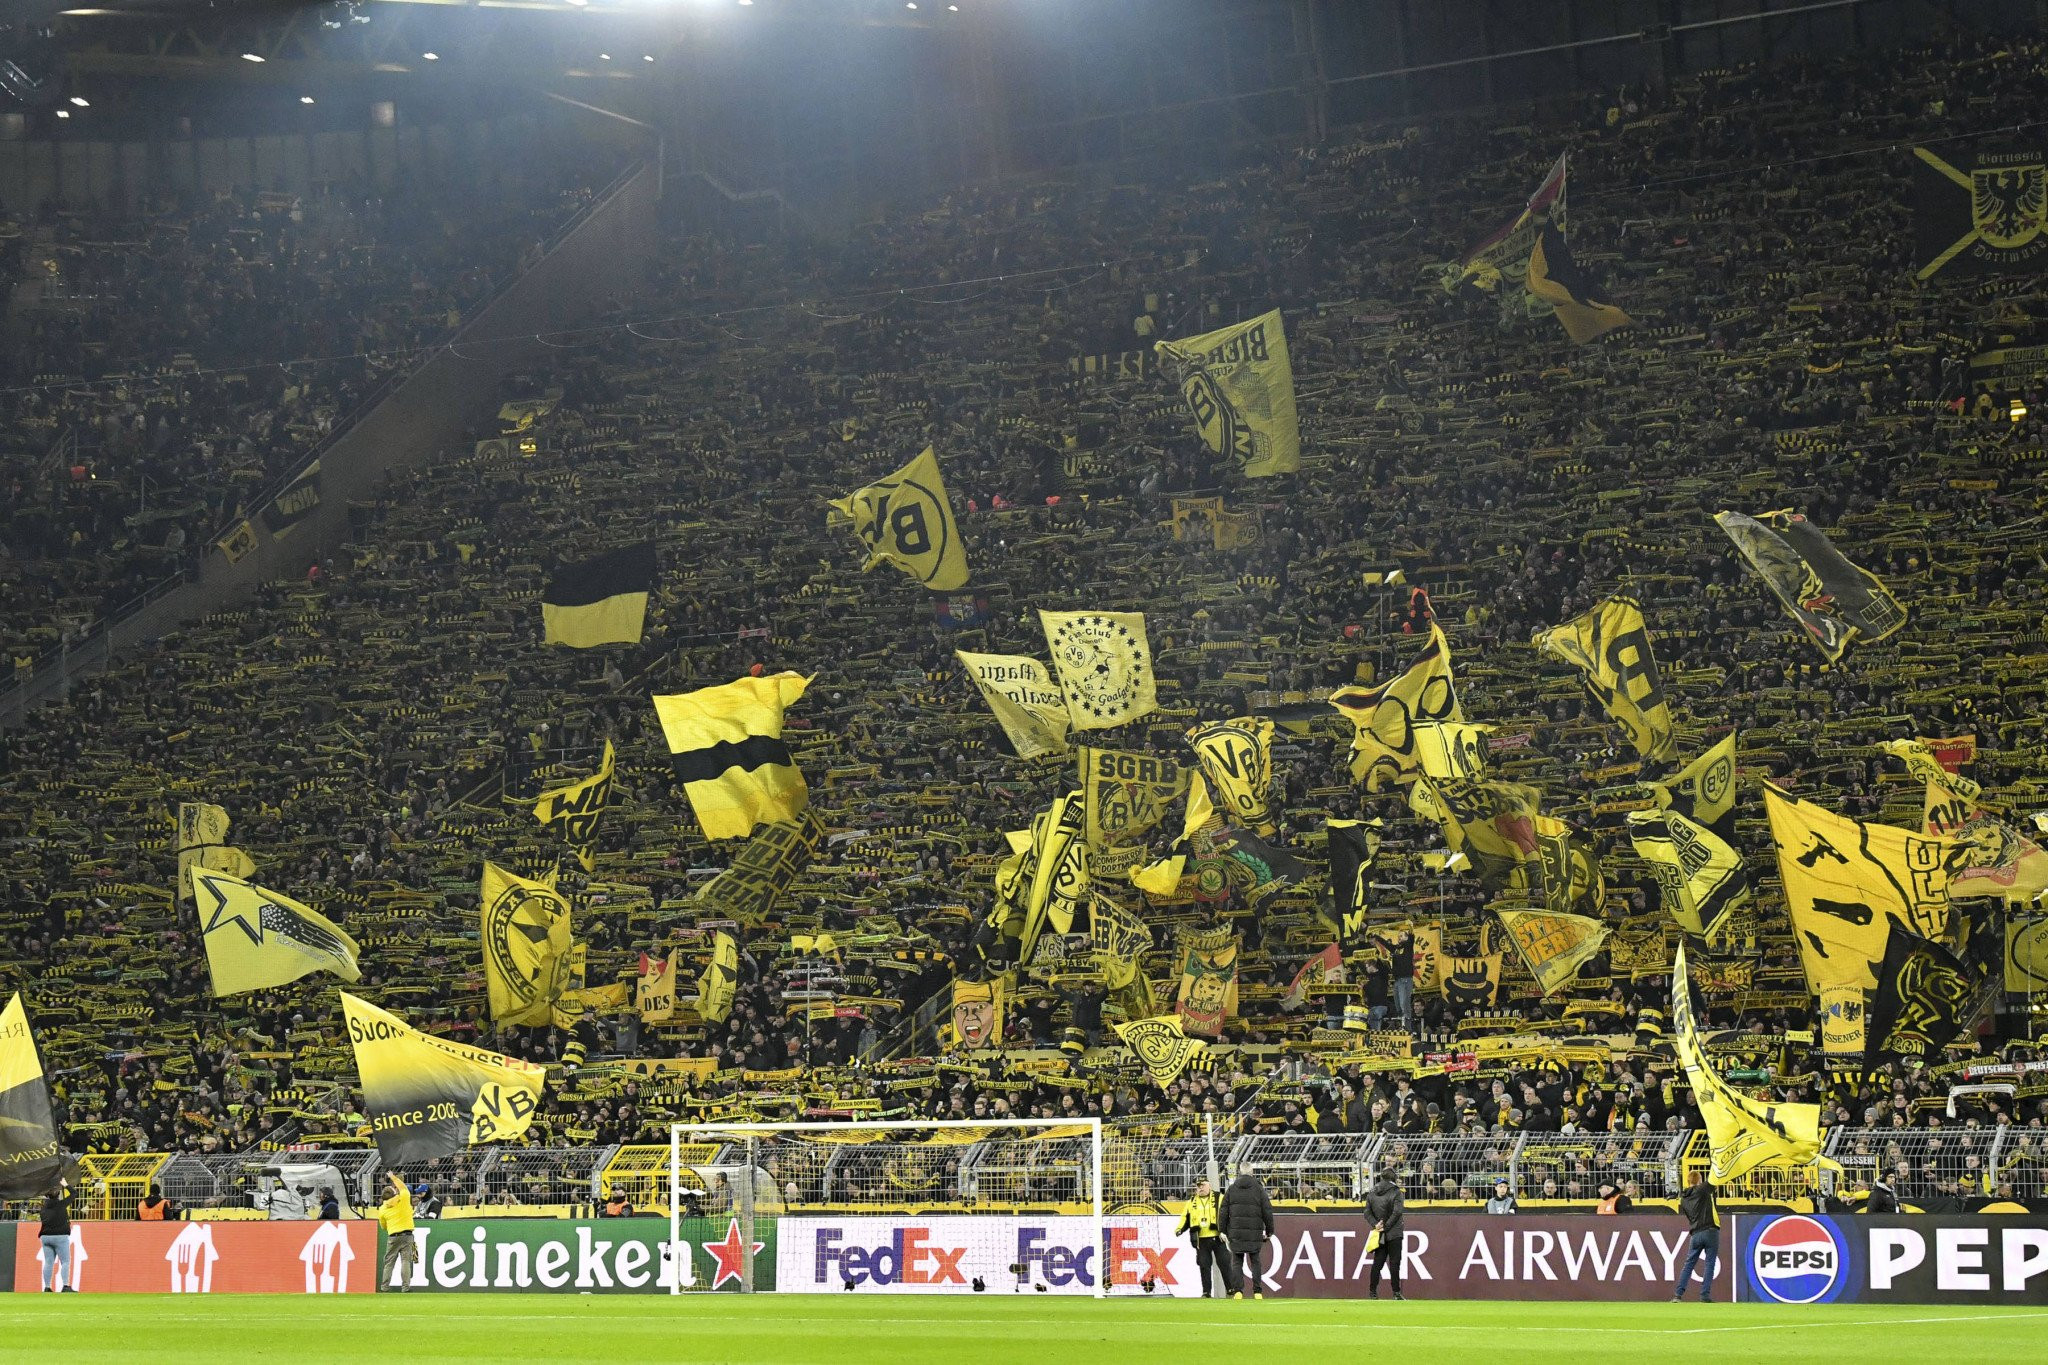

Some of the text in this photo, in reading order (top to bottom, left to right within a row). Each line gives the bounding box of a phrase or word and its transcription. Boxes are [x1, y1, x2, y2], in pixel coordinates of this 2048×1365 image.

[1099, 754, 1178, 783] SGRB
[1101, 861, 1141, 873] DORTMU
[644, 995, 670, 1011] DES
[1823, 1030, 1862, 1044] ESSENER
[373, 1112, 423, 1131] since
[476, 1086, 537, 1142] BVB
[815, 1228, 968, 1286] FedEx
[1018, 1228, 1179, 1287] FedEx
[1760, 1250, 1832, 1269] PEPSI
